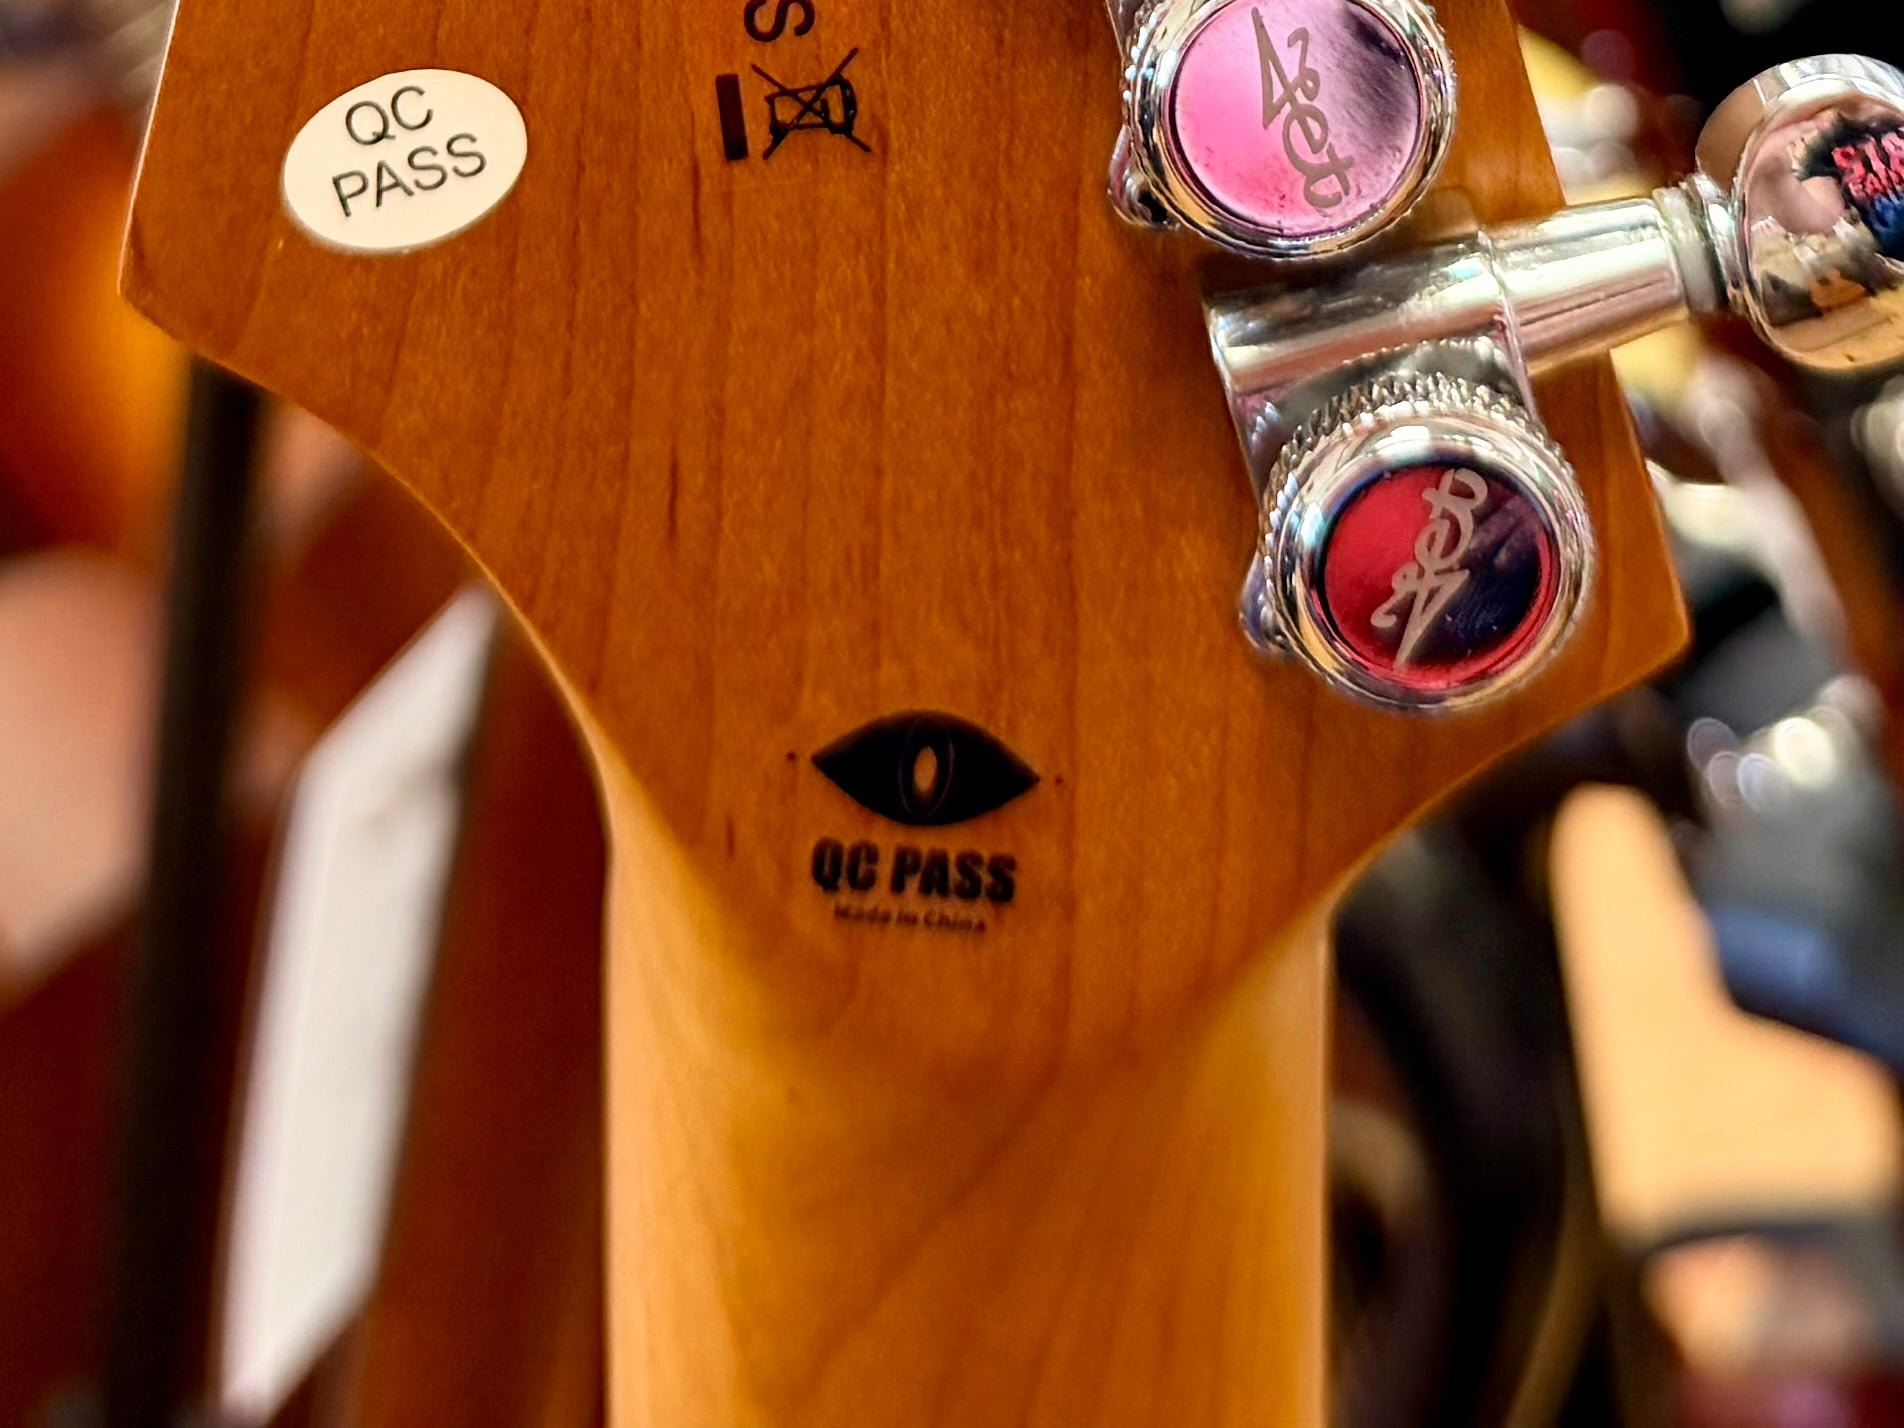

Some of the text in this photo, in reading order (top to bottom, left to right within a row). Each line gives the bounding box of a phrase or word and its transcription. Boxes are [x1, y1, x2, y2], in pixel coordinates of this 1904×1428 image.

[344, 85, 435, 149] QC
[331, 131, 487, 218] PASS
[811, 836, 1018, 903] QC PASS
[923, 909, 987, 934] China
